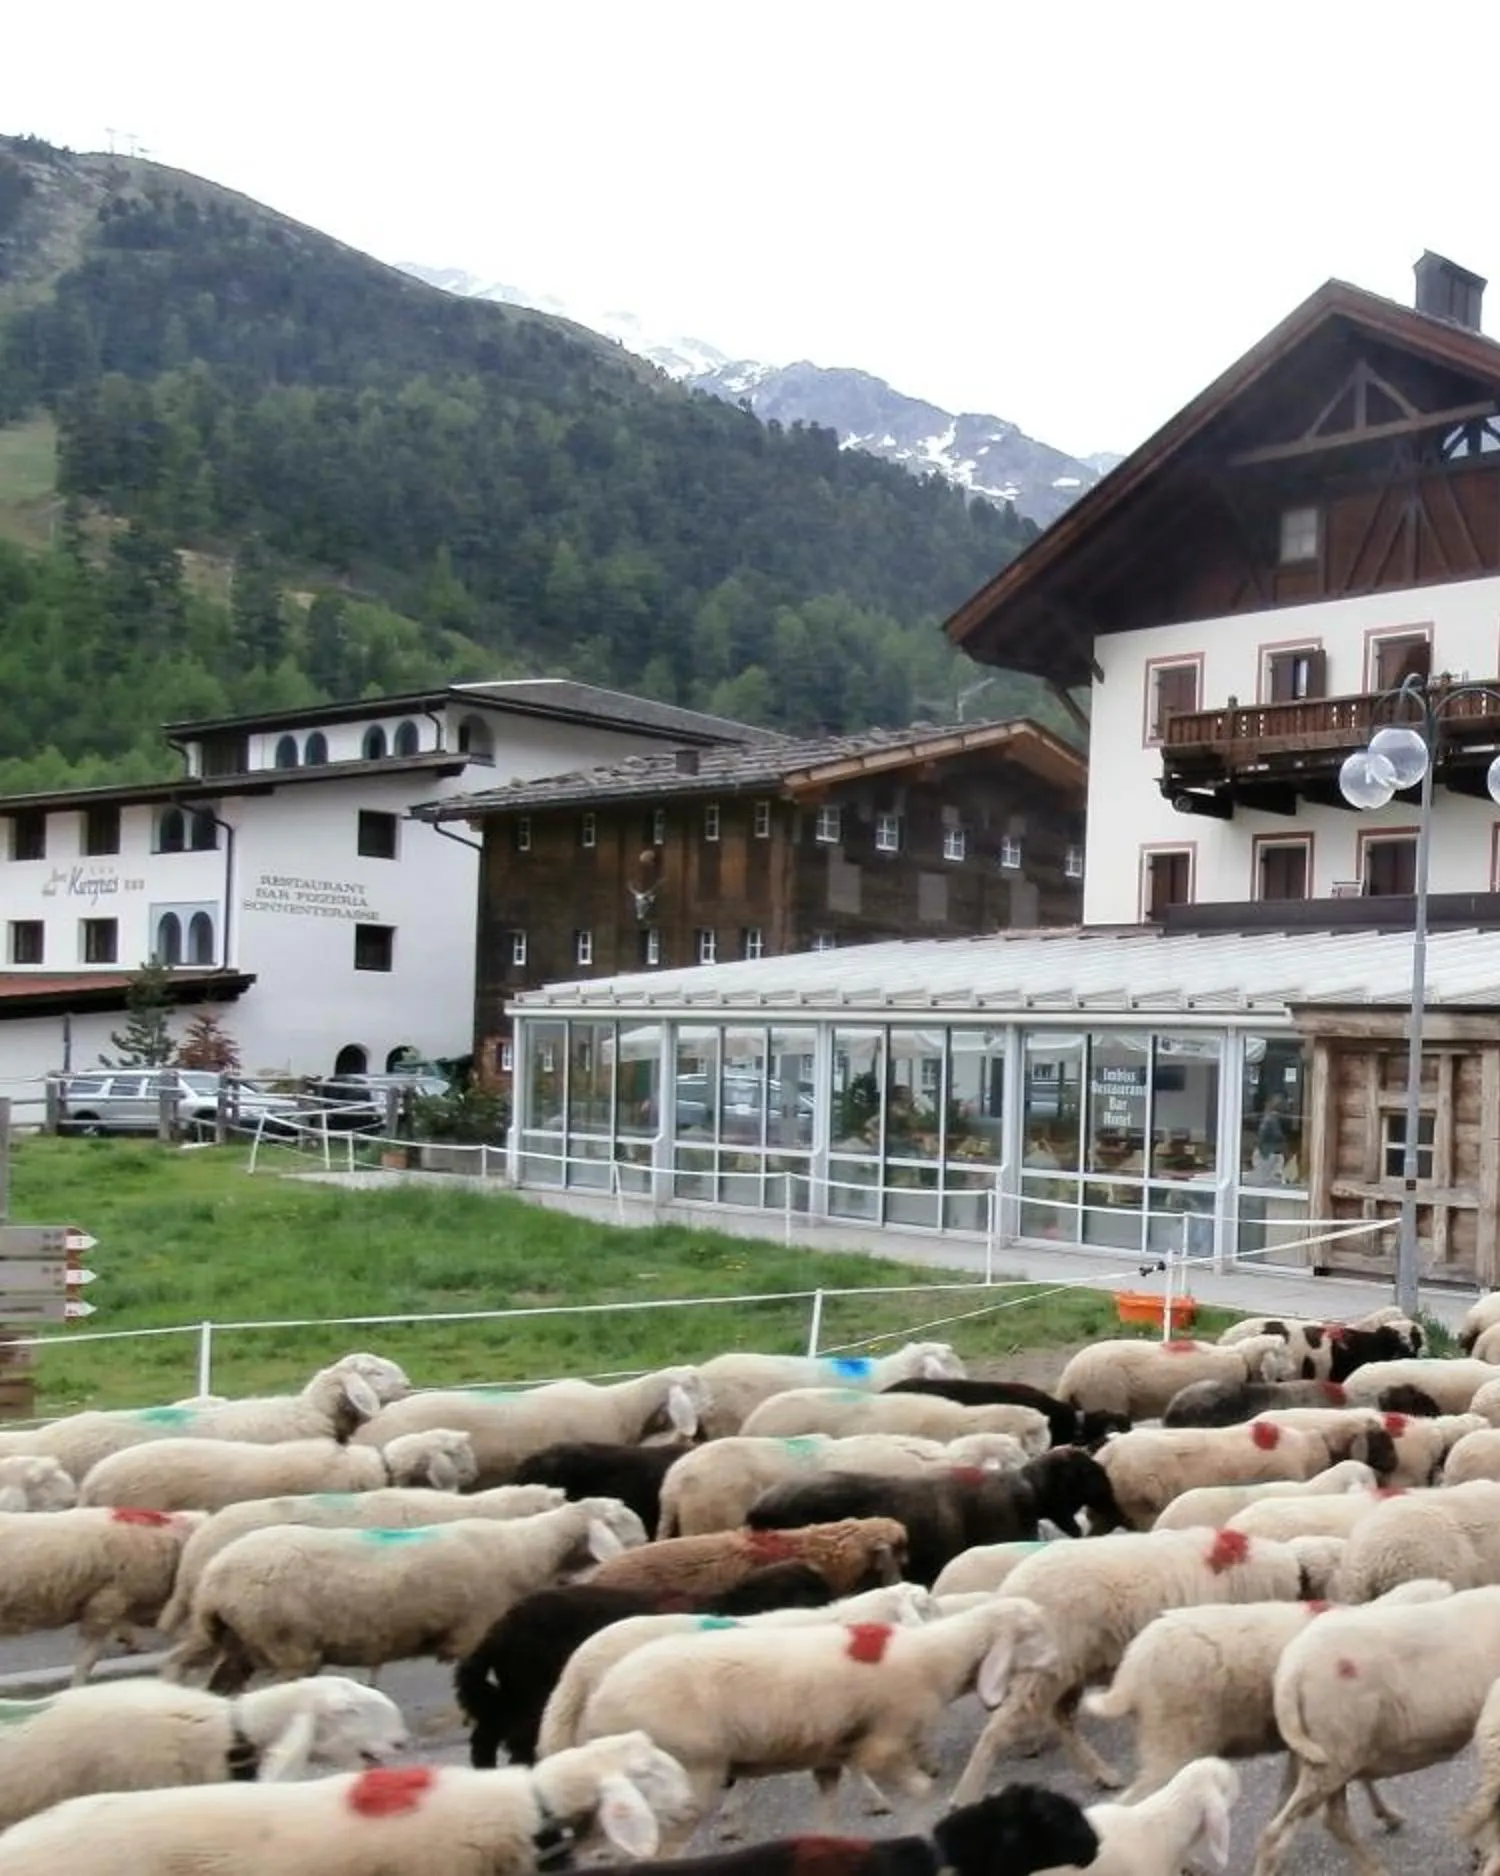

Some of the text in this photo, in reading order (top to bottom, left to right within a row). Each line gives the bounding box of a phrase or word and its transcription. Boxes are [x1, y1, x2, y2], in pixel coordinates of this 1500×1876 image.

[260, 874, 366, 895] RESTAURANT
[256, 886, 289, 901] BAR
[1109, 1095, 1128, 1110] Bar
